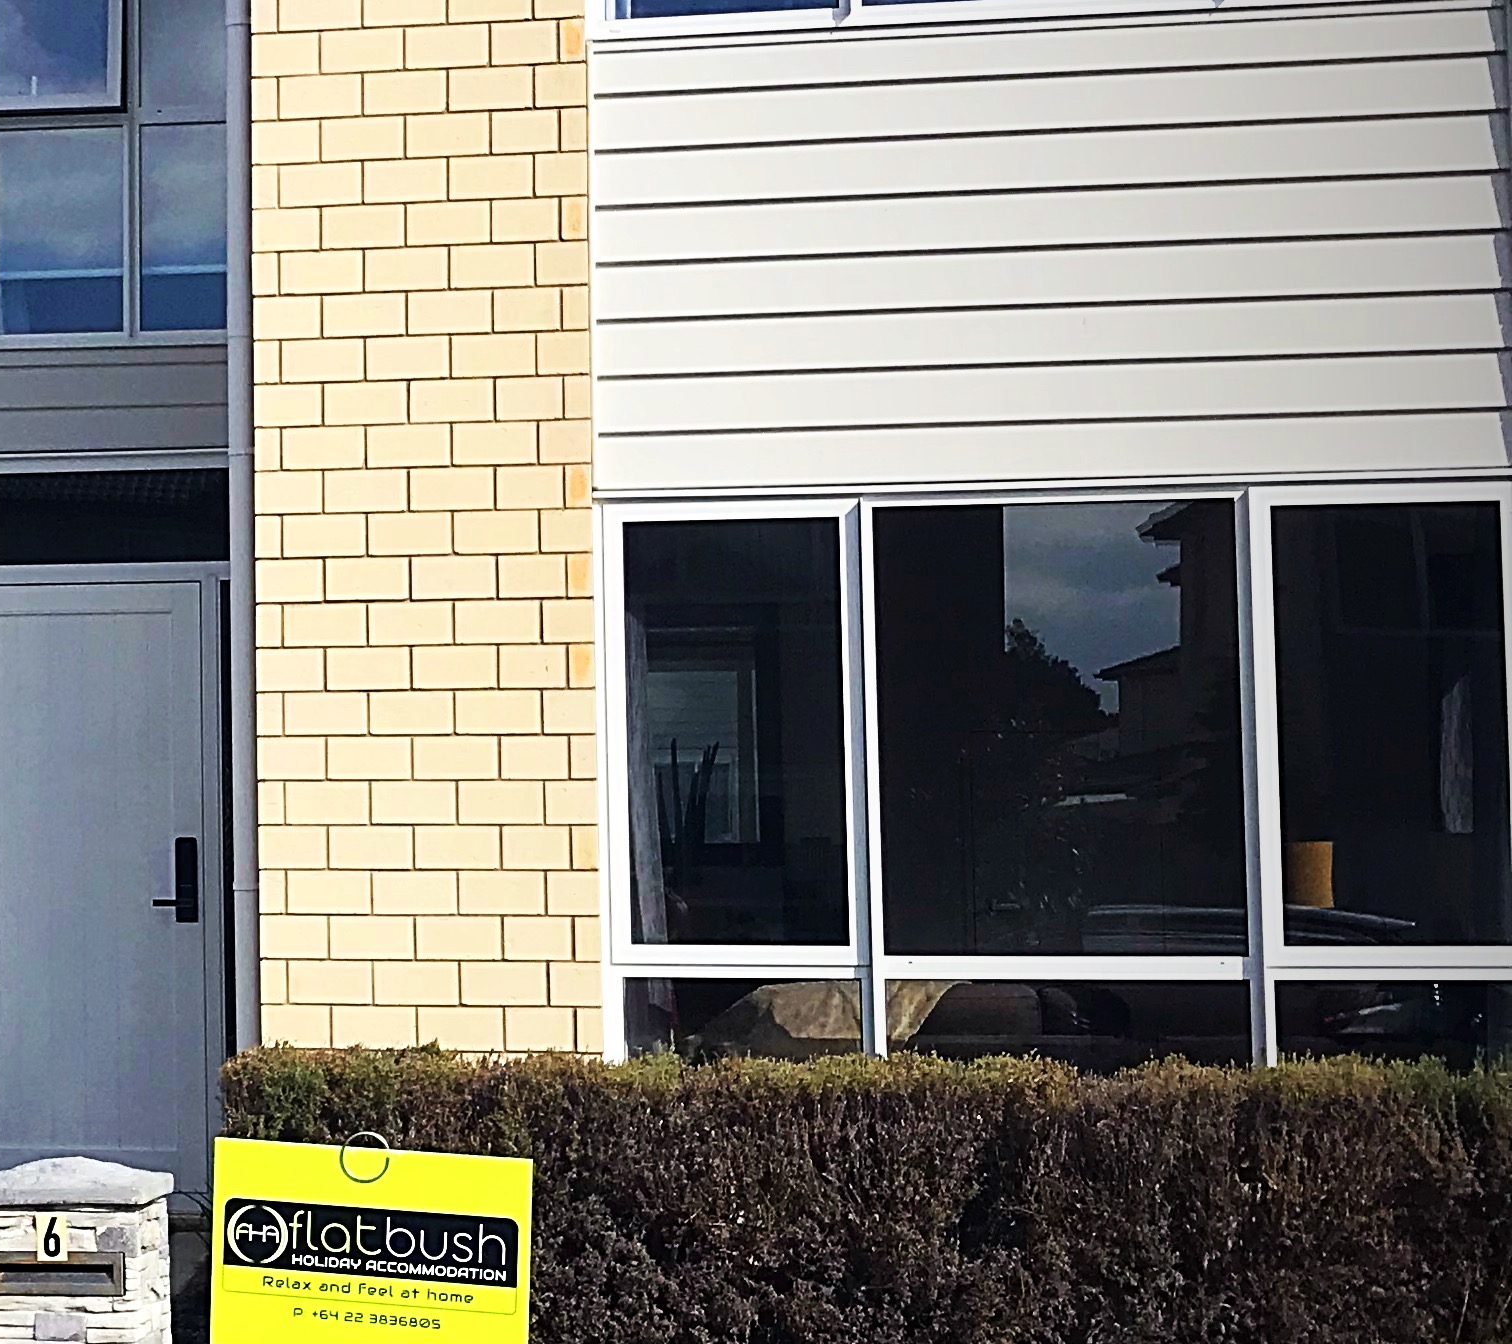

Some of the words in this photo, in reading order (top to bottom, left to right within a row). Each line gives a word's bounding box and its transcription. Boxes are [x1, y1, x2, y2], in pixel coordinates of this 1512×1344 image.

[43, 1216, 61, 1258] 6
[289, 1209, 507, 1266] flatbush
[291, 1253, 362, 1271] HOLIDAY
[365, 1259, 507, 1282] ACCOMMODATION
[262, 1275, 312, 1291] Relax
[319, 1282, 351, 1294] and
[358, 1282, 393, 1298] Feel
[400, 1288, 420, 1299] at
[427, 1288, 474, 1304] home
[312, 1309, 339, 1320] +64
[344, 1312, 363, 1323] 22
[369, 1313, 441, 1330] 3836805
